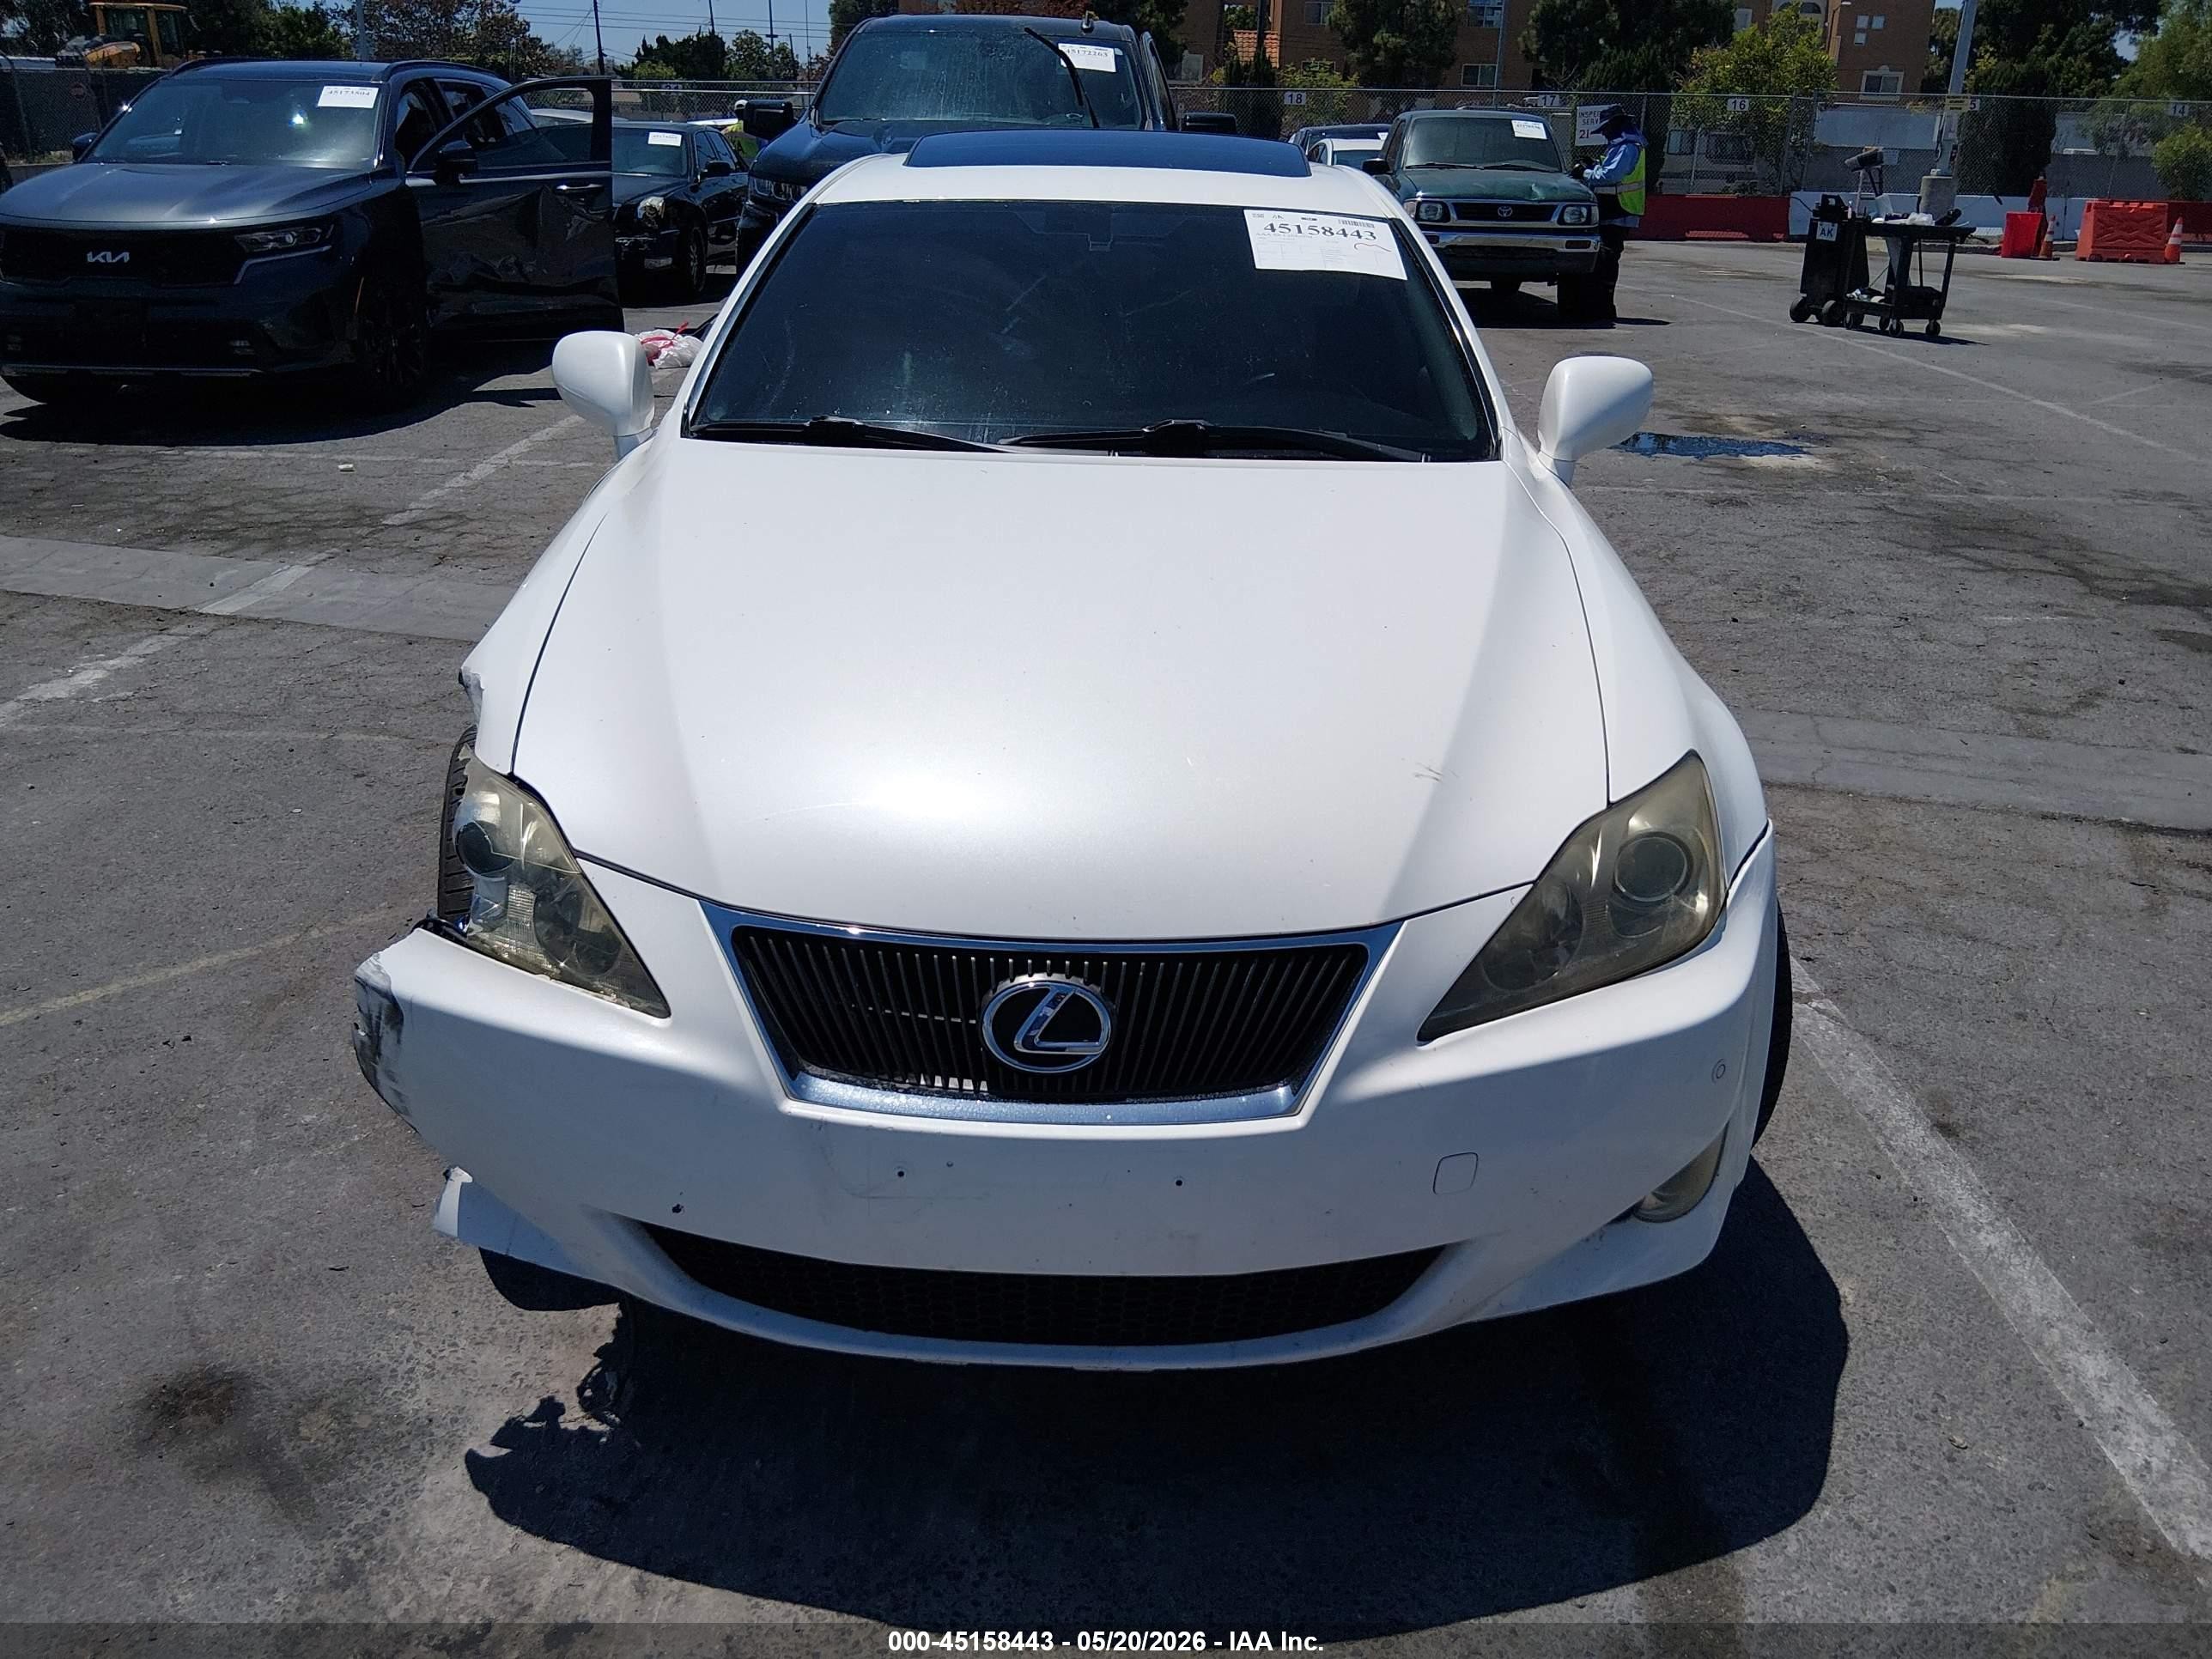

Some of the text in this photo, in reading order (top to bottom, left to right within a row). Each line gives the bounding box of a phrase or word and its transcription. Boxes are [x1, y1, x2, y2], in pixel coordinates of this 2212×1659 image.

[1288, 94, 1303, 104] 18
[1541, 95, 1556, 106] 17
[1731, 100, 1746, 110] 16
[2172, 105, 2185, 116] 14
[1263, 222, 1377, 240] 45158443
[1820, 228, 1833, 238] AK
